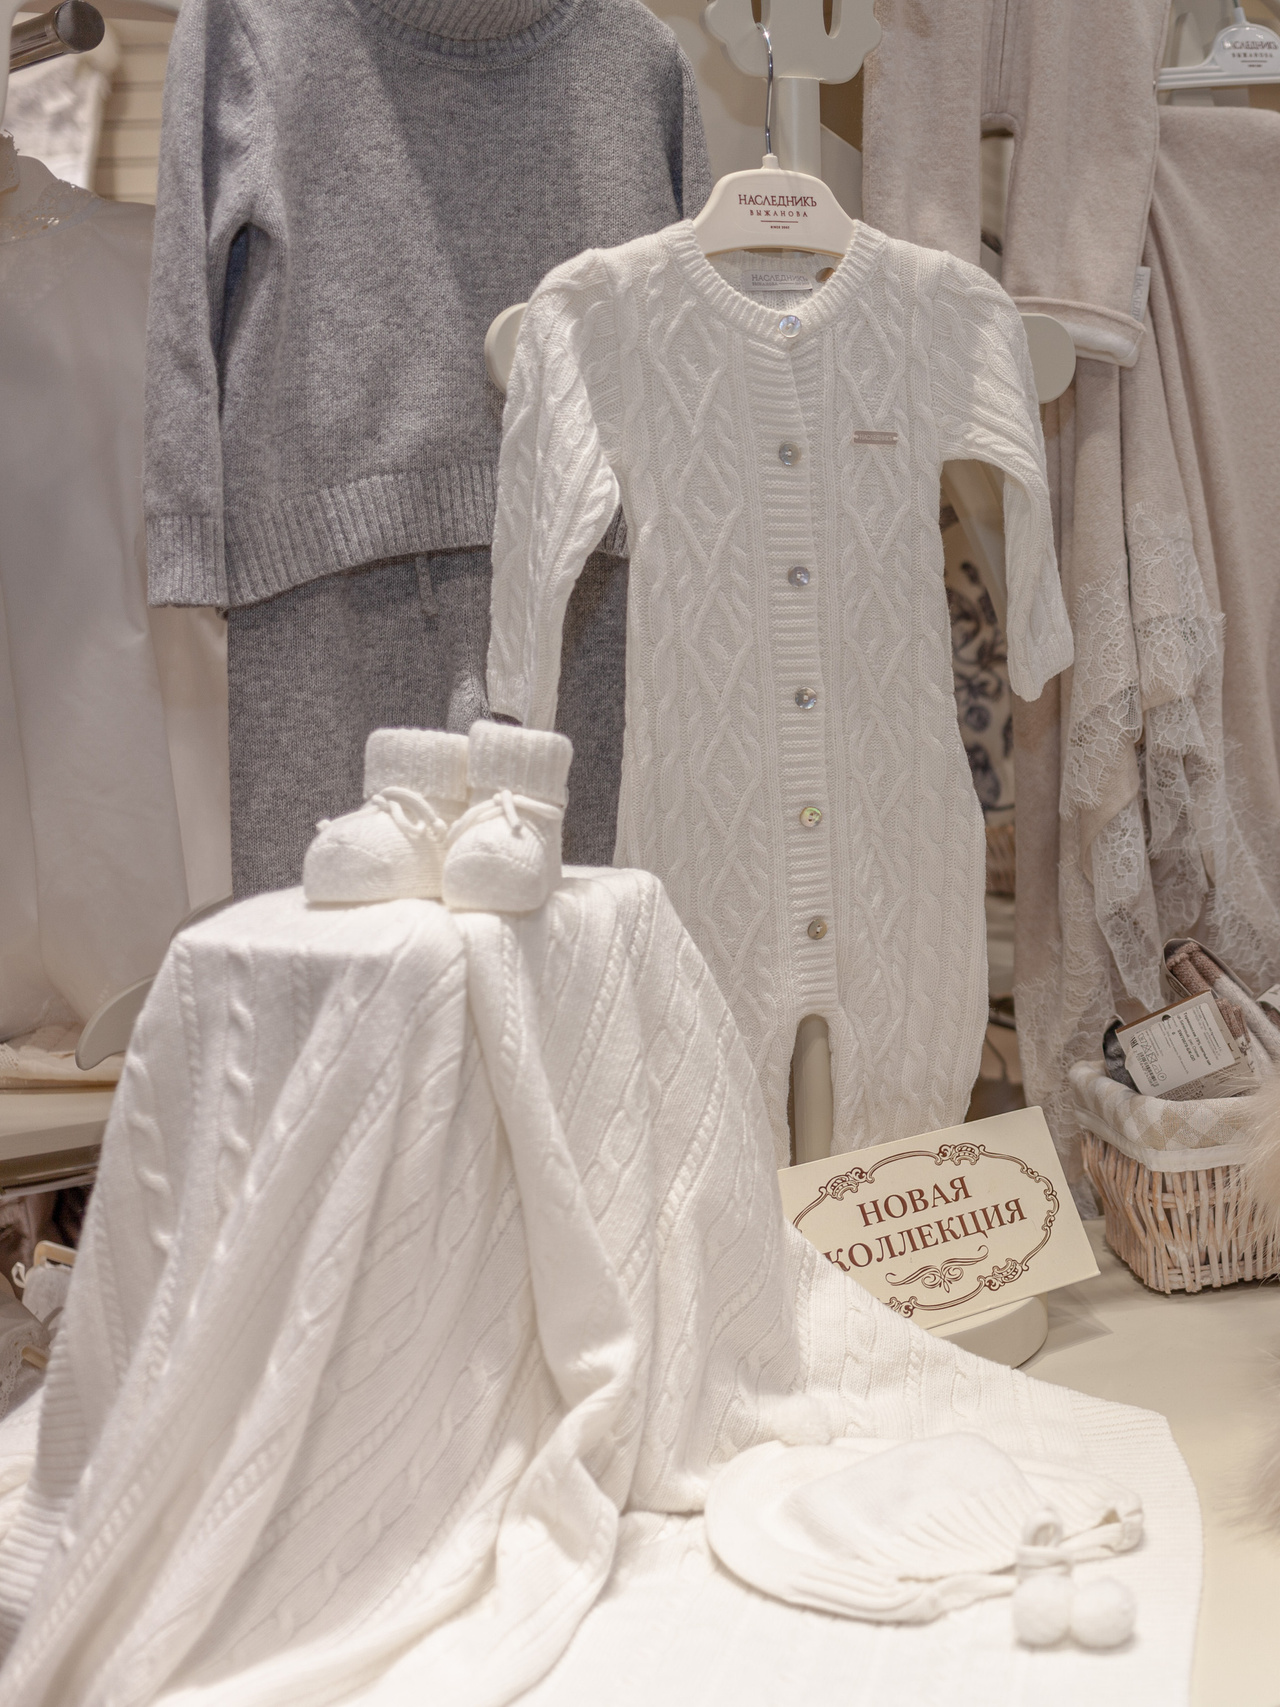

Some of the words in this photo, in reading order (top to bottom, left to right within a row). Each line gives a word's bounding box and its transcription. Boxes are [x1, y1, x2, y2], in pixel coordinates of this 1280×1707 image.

[738, 194, 817, 207] НАСЛЕДНИКЪ
[749, 209, 808, 217] ВЫЖАНОВА
[856, 1175, 972, 1227] НОВАЯ
[822, 1197, 1027, 1273] КОЛЛЕКЦИЯ
